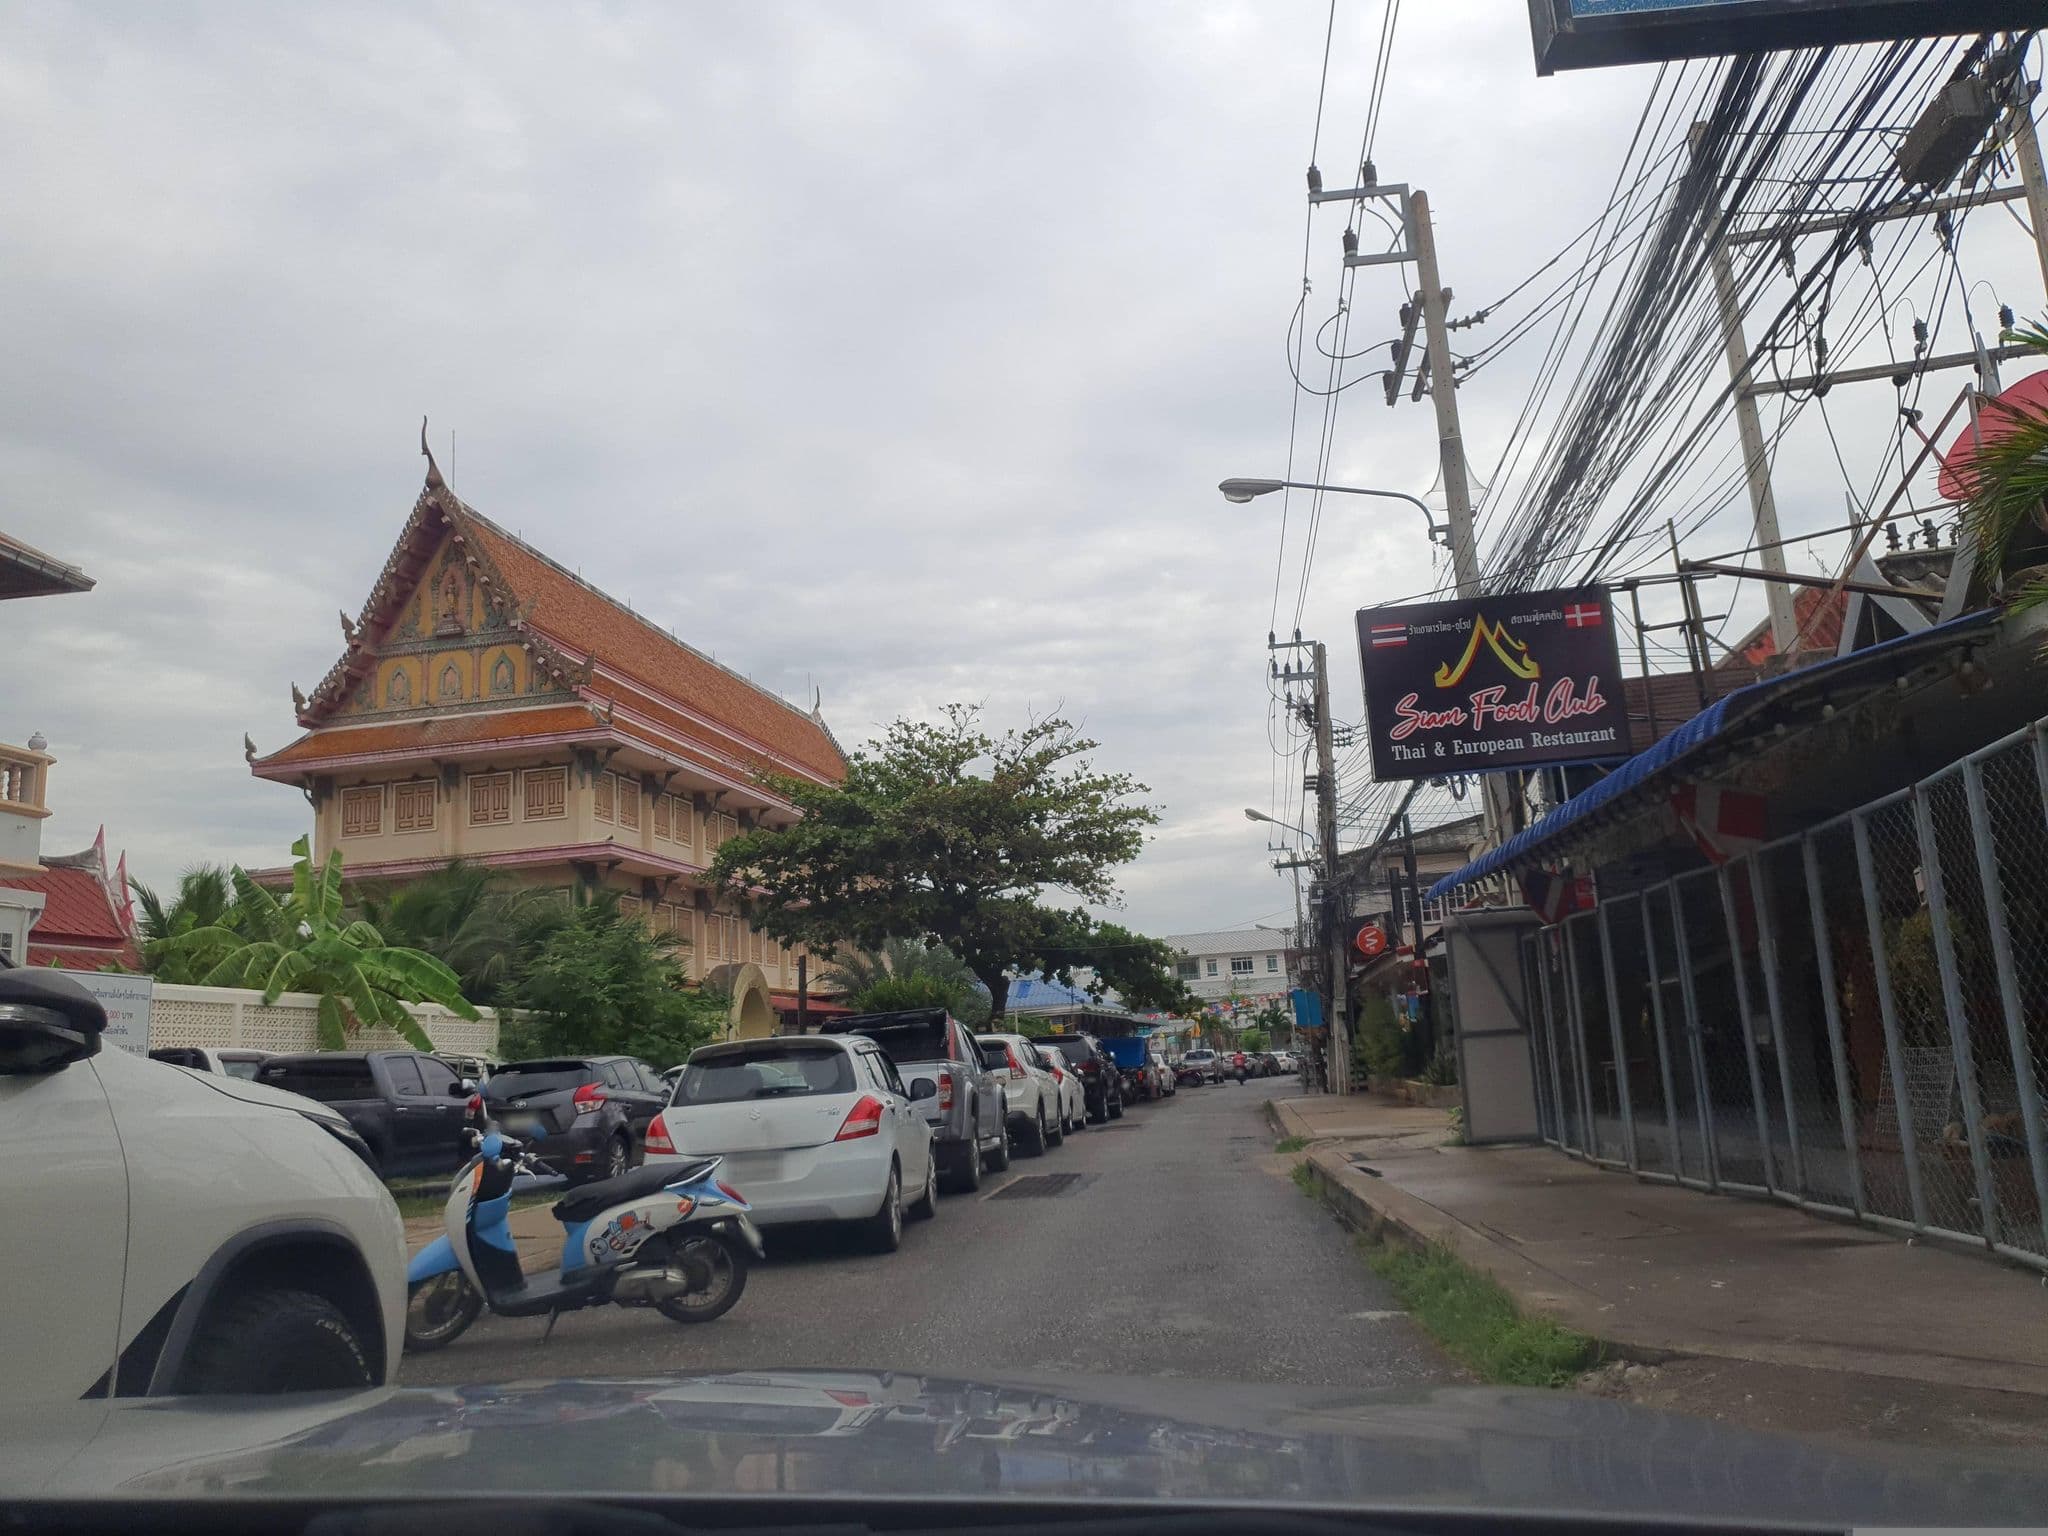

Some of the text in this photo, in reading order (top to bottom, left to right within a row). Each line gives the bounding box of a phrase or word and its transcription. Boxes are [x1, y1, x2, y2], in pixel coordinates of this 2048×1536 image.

[1390, 676, 1606, 740] Siam Food Club
[1391, 727, 1617, 760] Thai & European Restaurant
